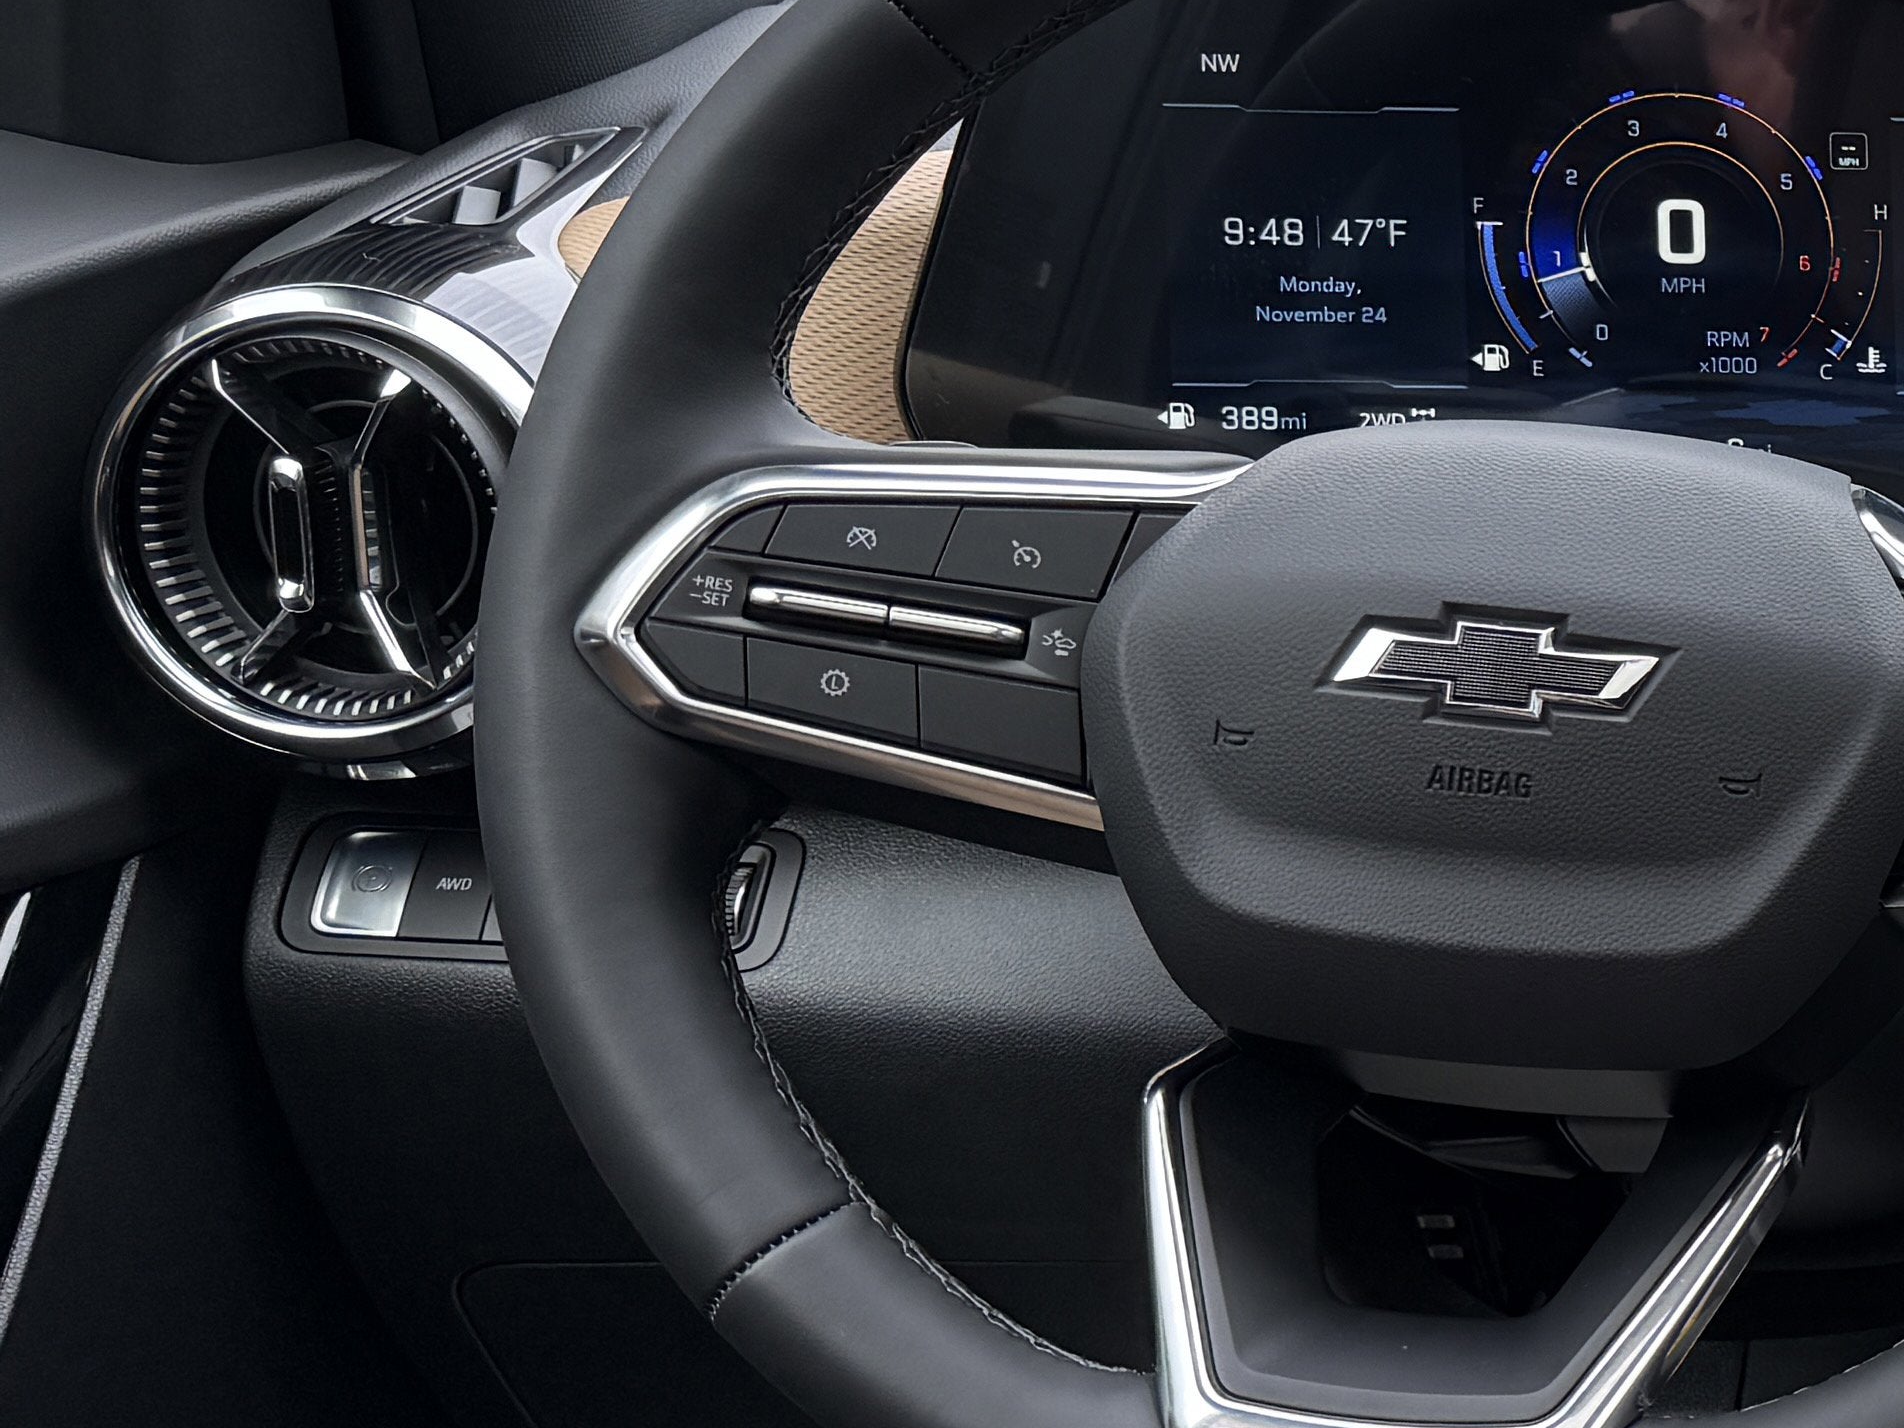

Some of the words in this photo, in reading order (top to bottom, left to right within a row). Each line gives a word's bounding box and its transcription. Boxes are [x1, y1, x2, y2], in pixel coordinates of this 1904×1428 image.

[1201, 53, 1240, 72] NW
[1627, 120, 1639, 137] 3
[1716, 121, 1728, 139] 4
[1566, 169, 1577, 185] 2
[1780, 174, 1792, 191] 5
[1473, 197, 1484, 214] F
[1873, 203, 1888, 221] H
[1223, 217, 1304, 247] 9:48
[1332, 218, 1408, 248] 47°F
[1657, 198, 1706, 264] 0
[1553, 251, 1561, 266] 1
[1798, 255, 1810, 271] 6
[1279, 275, 1361, 297] Monday,
[1661, 277, 1705, 294] MPH
[1256, 305, 1356, 323] November
[1361, 306, 1387, 323] 24
[1596, 324, 1609, 341] 0
[1707, 330, 1750, 349] RPM
[1759, 327, 1770, 343] 7
[1532, 360, 1544, 377] E
[1700, 356, 1757, 374] x1000
[1819, 363, 1833, 381] C
[1426, 765, 1532, 798] AIRBAG
[436, 876, 472, 892] AWD
